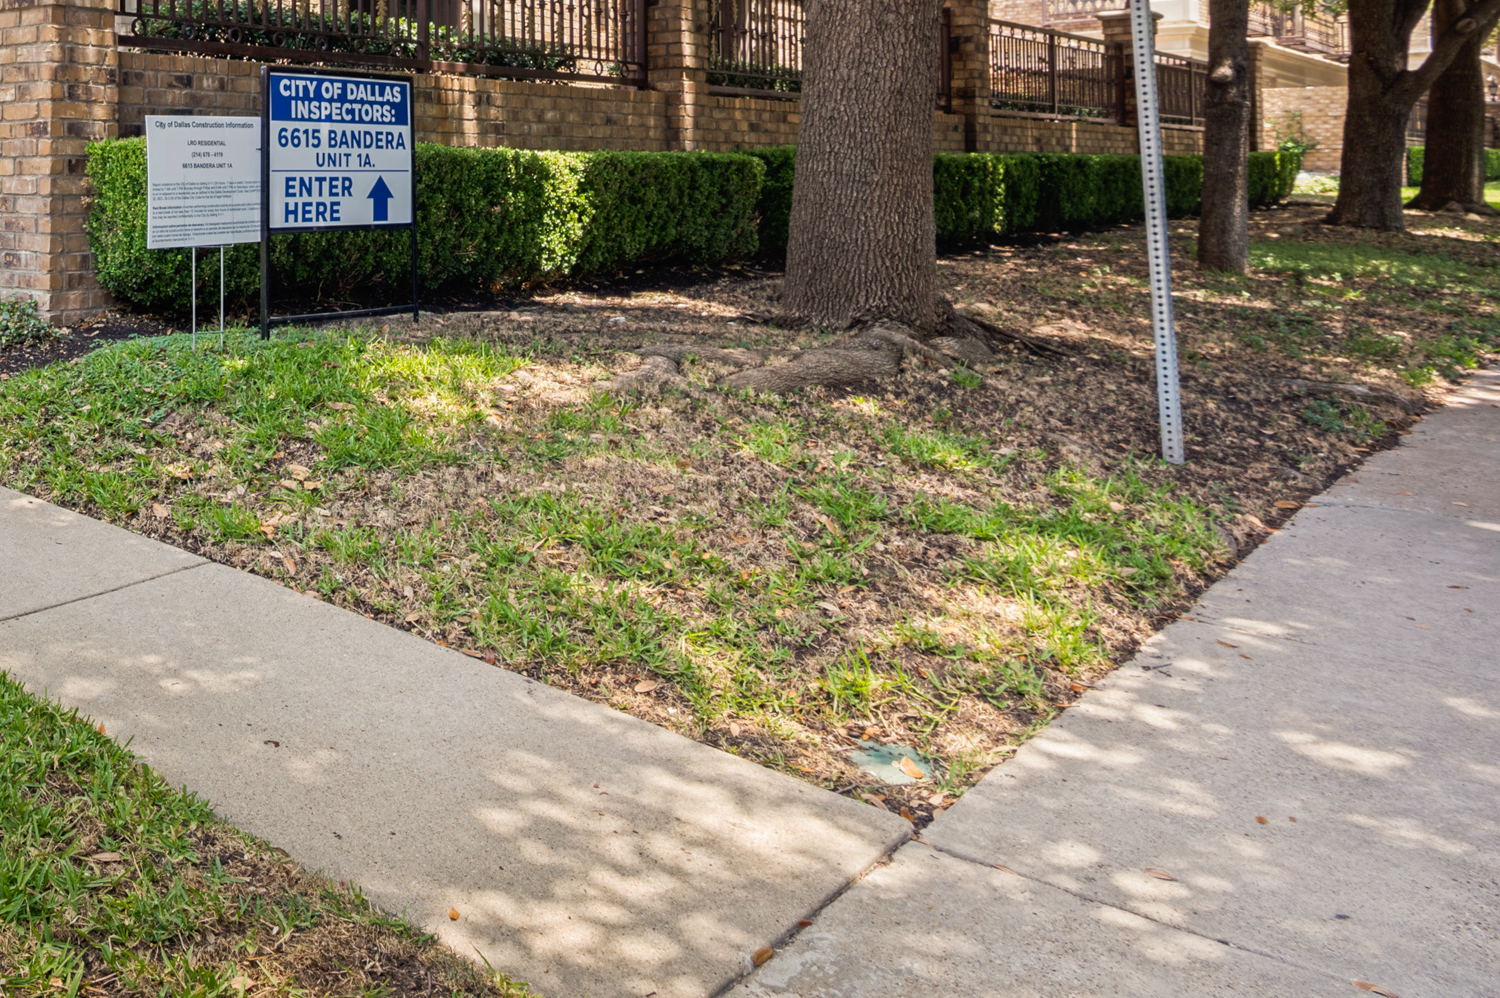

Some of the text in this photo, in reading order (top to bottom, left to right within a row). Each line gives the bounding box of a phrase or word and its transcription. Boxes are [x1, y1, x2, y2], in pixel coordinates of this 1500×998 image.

[279, 79, 401, 103] CITY OF DALLAS
[291, 100, 396, 123] INSPECTORS:
[155, 121, 166, 129] City
[191, 121, 224, 129] Construction
[225, 121, 254, 129] Information
[278, 127, 406, 150] 6615 BANDERA
[316, 152, 375, 168] UNIT 1A.
[284, 176, 353, 198] ENTER
[284, 201, 341, 223] HERE
